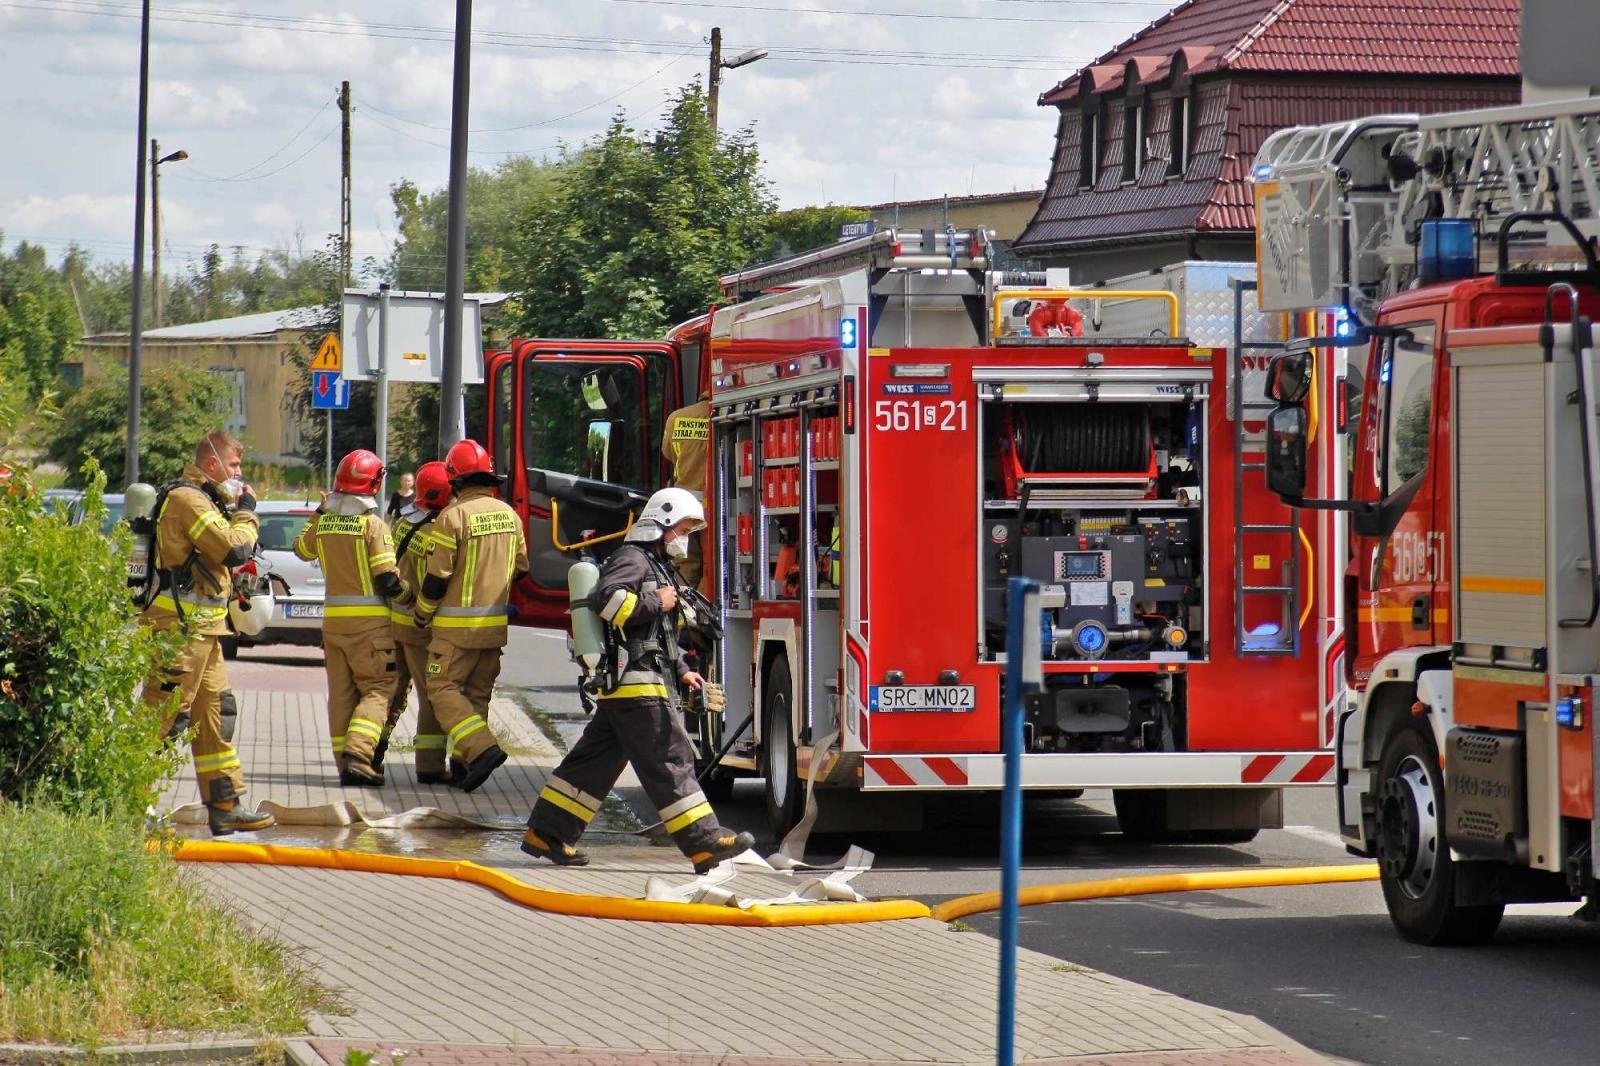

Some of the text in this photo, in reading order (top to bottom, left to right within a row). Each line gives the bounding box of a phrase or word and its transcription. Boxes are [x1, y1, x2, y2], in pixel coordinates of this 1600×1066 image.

[885, 384, 914, 393] WISS
[882, 688, 970, 706] SRC MN02
